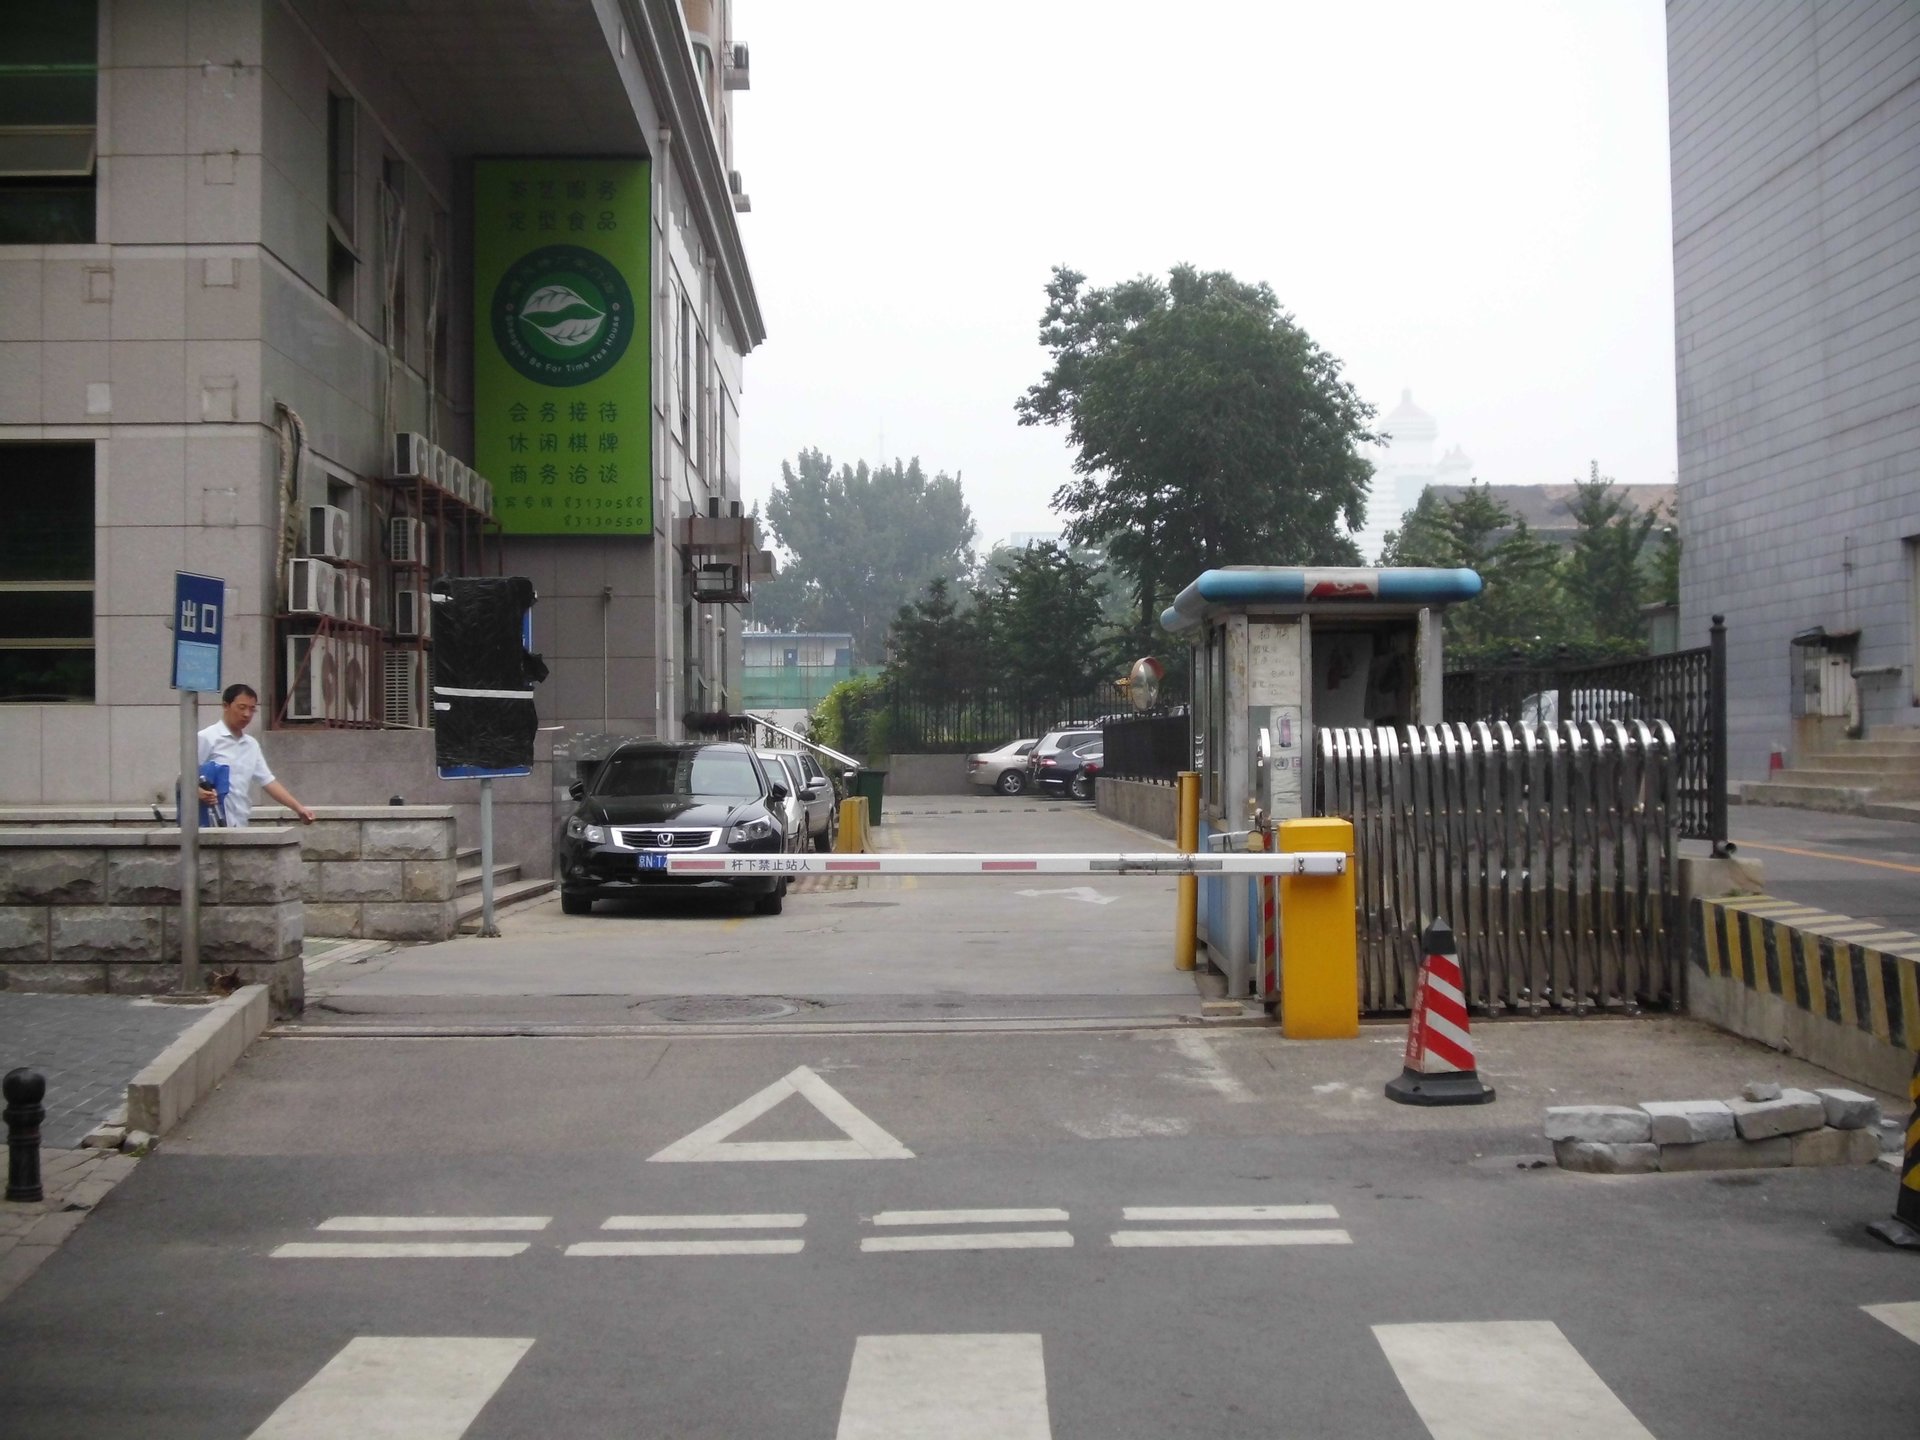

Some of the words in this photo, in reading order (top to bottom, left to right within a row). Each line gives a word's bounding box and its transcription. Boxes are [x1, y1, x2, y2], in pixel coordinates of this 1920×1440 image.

[566, 360, 590, 372] Time
[592, 348, 607, 363] Tea
[605, 316, 621, 346] House
[508, 401, 617, 423] 会务接待
[508, 432, 618, 453] 休闲棋牌
[509, 463, 618, 485] 商务洽谈
[563, 496, 644, 509] 83130588
[563, 514, 644, 527] 83130550
[181, 599, 218, 634] 出口
[731, 858, 811, 871] 杆下禁止站人
